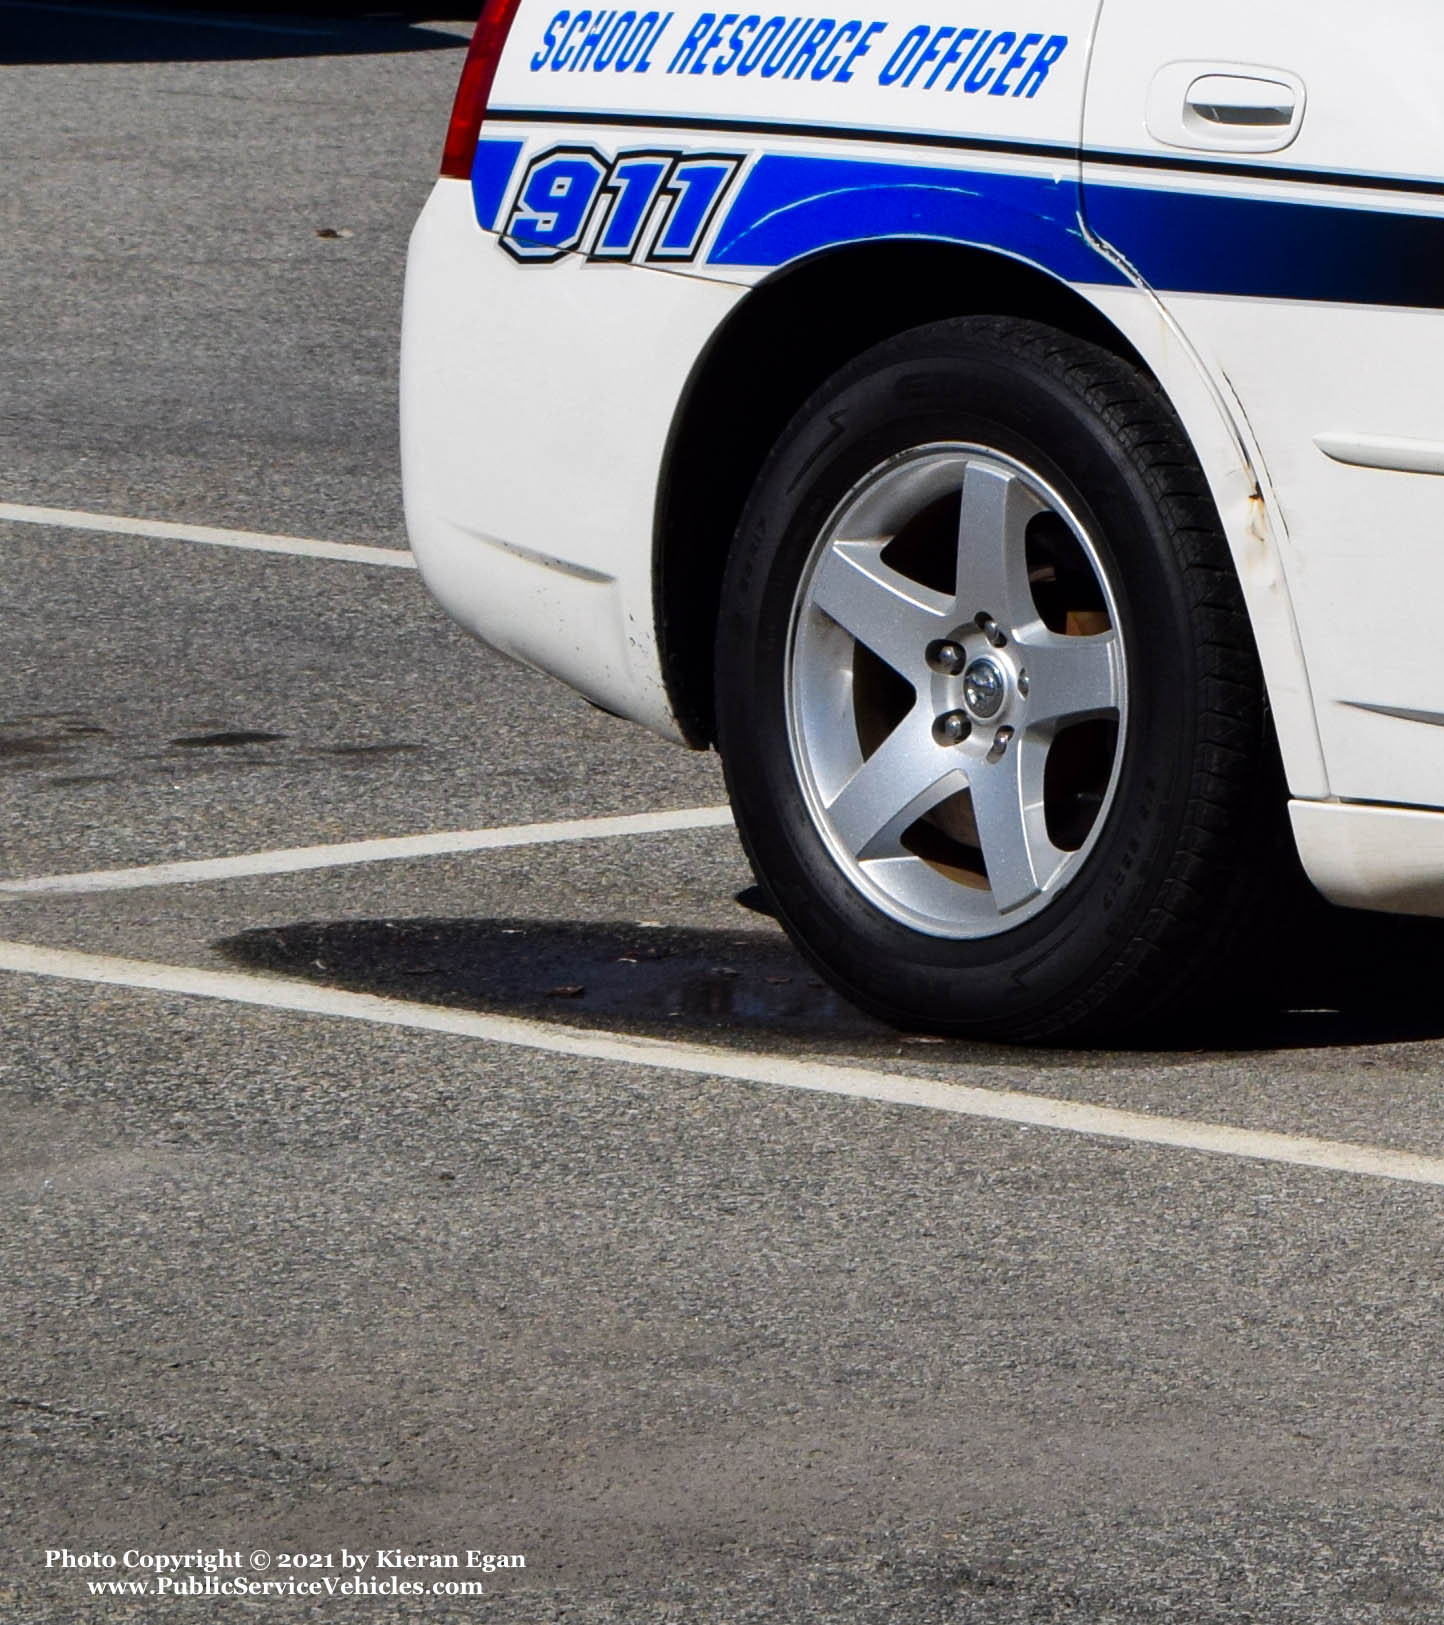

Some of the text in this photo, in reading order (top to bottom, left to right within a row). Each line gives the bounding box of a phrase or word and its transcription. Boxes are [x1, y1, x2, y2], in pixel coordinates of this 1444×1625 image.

[530, 9, 1068, 98] SCHOOL RESOURCE OFFICER
[499, 146, 747, 264] 911
